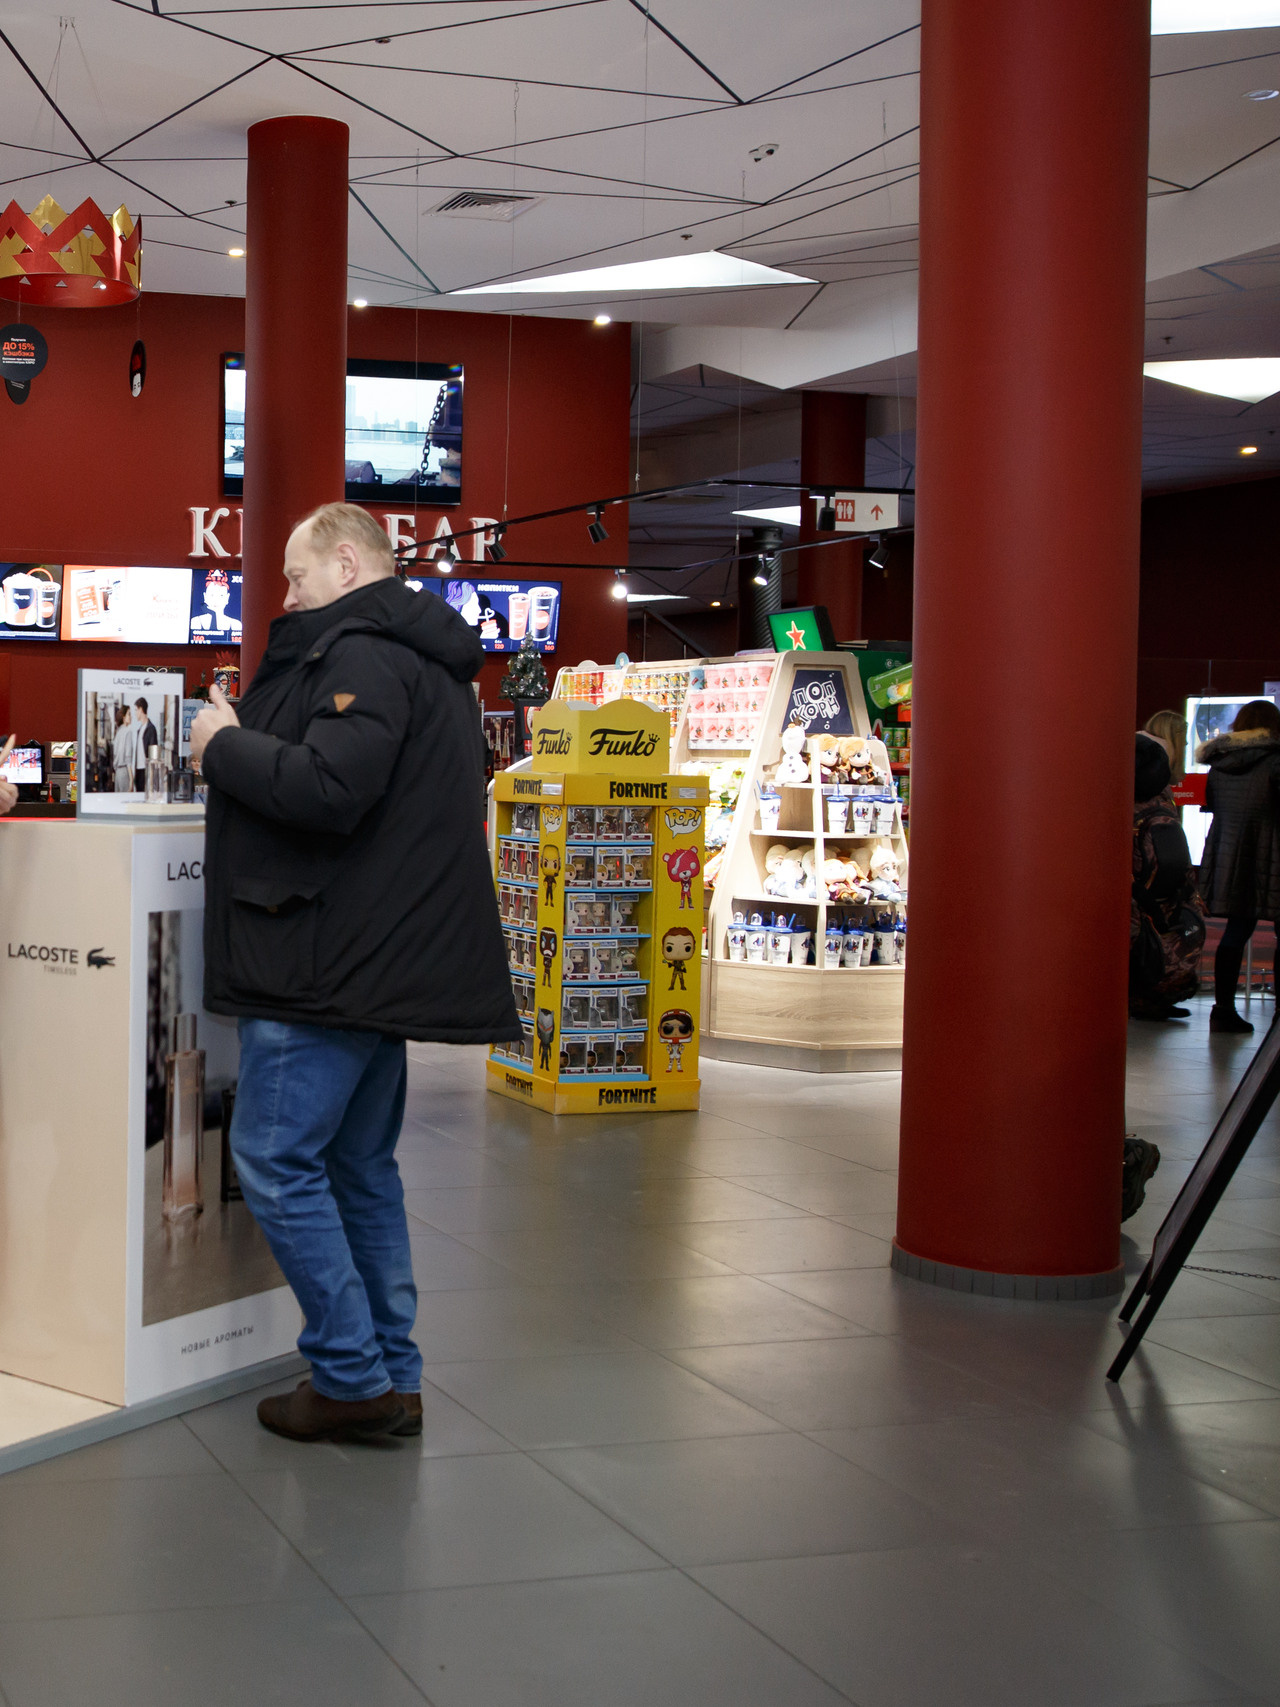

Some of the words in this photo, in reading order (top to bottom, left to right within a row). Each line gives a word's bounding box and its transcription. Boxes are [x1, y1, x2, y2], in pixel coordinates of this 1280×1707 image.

[3, 342, 17, 350] ДО
[112, 677, 141, 686] LACOSTE
[536, 728, 571, 756] Funko
[588, 728, 658, 757] Funko
[513, 777, 543, 797] FORTNITE
[609, 781, 668, 799] FORTNITE
[542, 805, 562, 826] POP!
[665, 808, 702, 828] POP!
[7, 942, 79, 964] LACOSTE
[505, 1072, 533, 1098] FORTNITE
[598, 1086, 658, 1106] FORTNITE
[180, 1337, 211, 1356] НОВЫЕ
[213, 1325, 255, 1345] АРОМАТЫ
